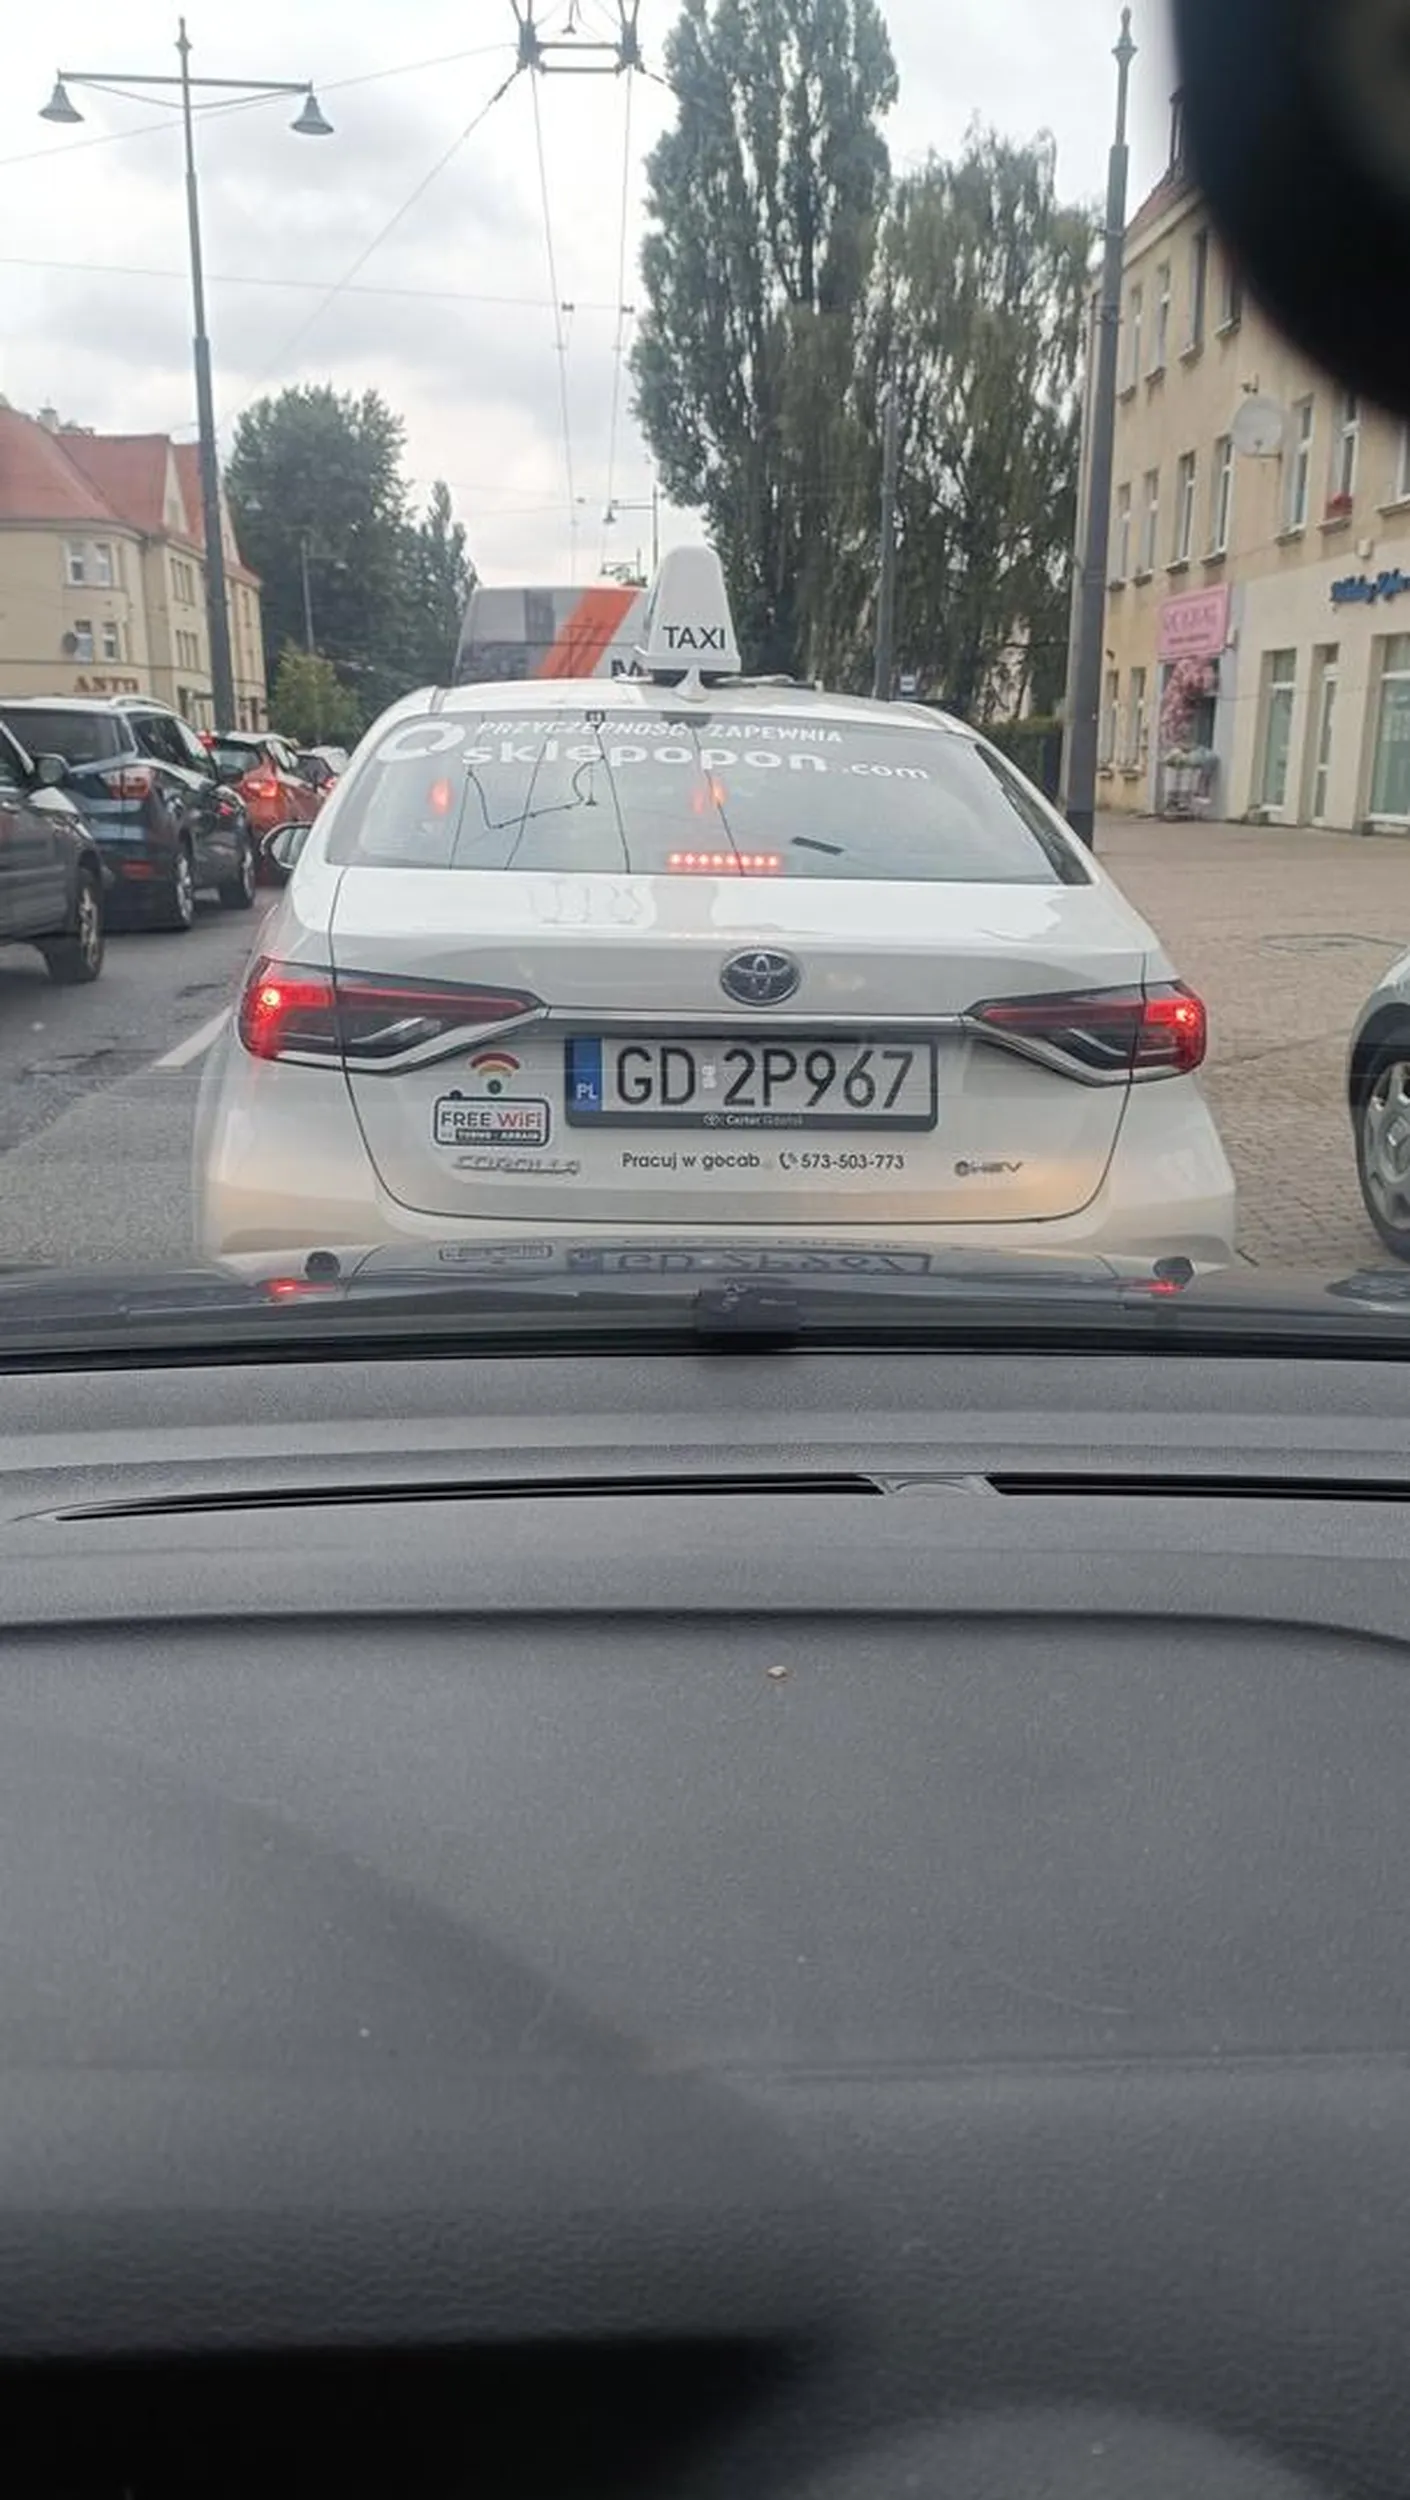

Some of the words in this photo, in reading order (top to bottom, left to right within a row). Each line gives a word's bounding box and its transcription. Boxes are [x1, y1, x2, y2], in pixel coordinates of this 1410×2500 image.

[663, 626, 726, 649] TAXI
[706, 724, 843, 743] ZAPEWNIA
[616, 1046, 696, 1106] GD
[722, 1047, 915, 1109] 2P967
[576, 1083, 599, 1100] PL
[441, 1111, 492, 1127] FREE
[622, 1152, 677, 1169] Pracuj
[682, 1155, 697, 1168] w
[702, 1152, 761, 1171] gocab
[801, 1153, 905, 1170] 573-503-773
